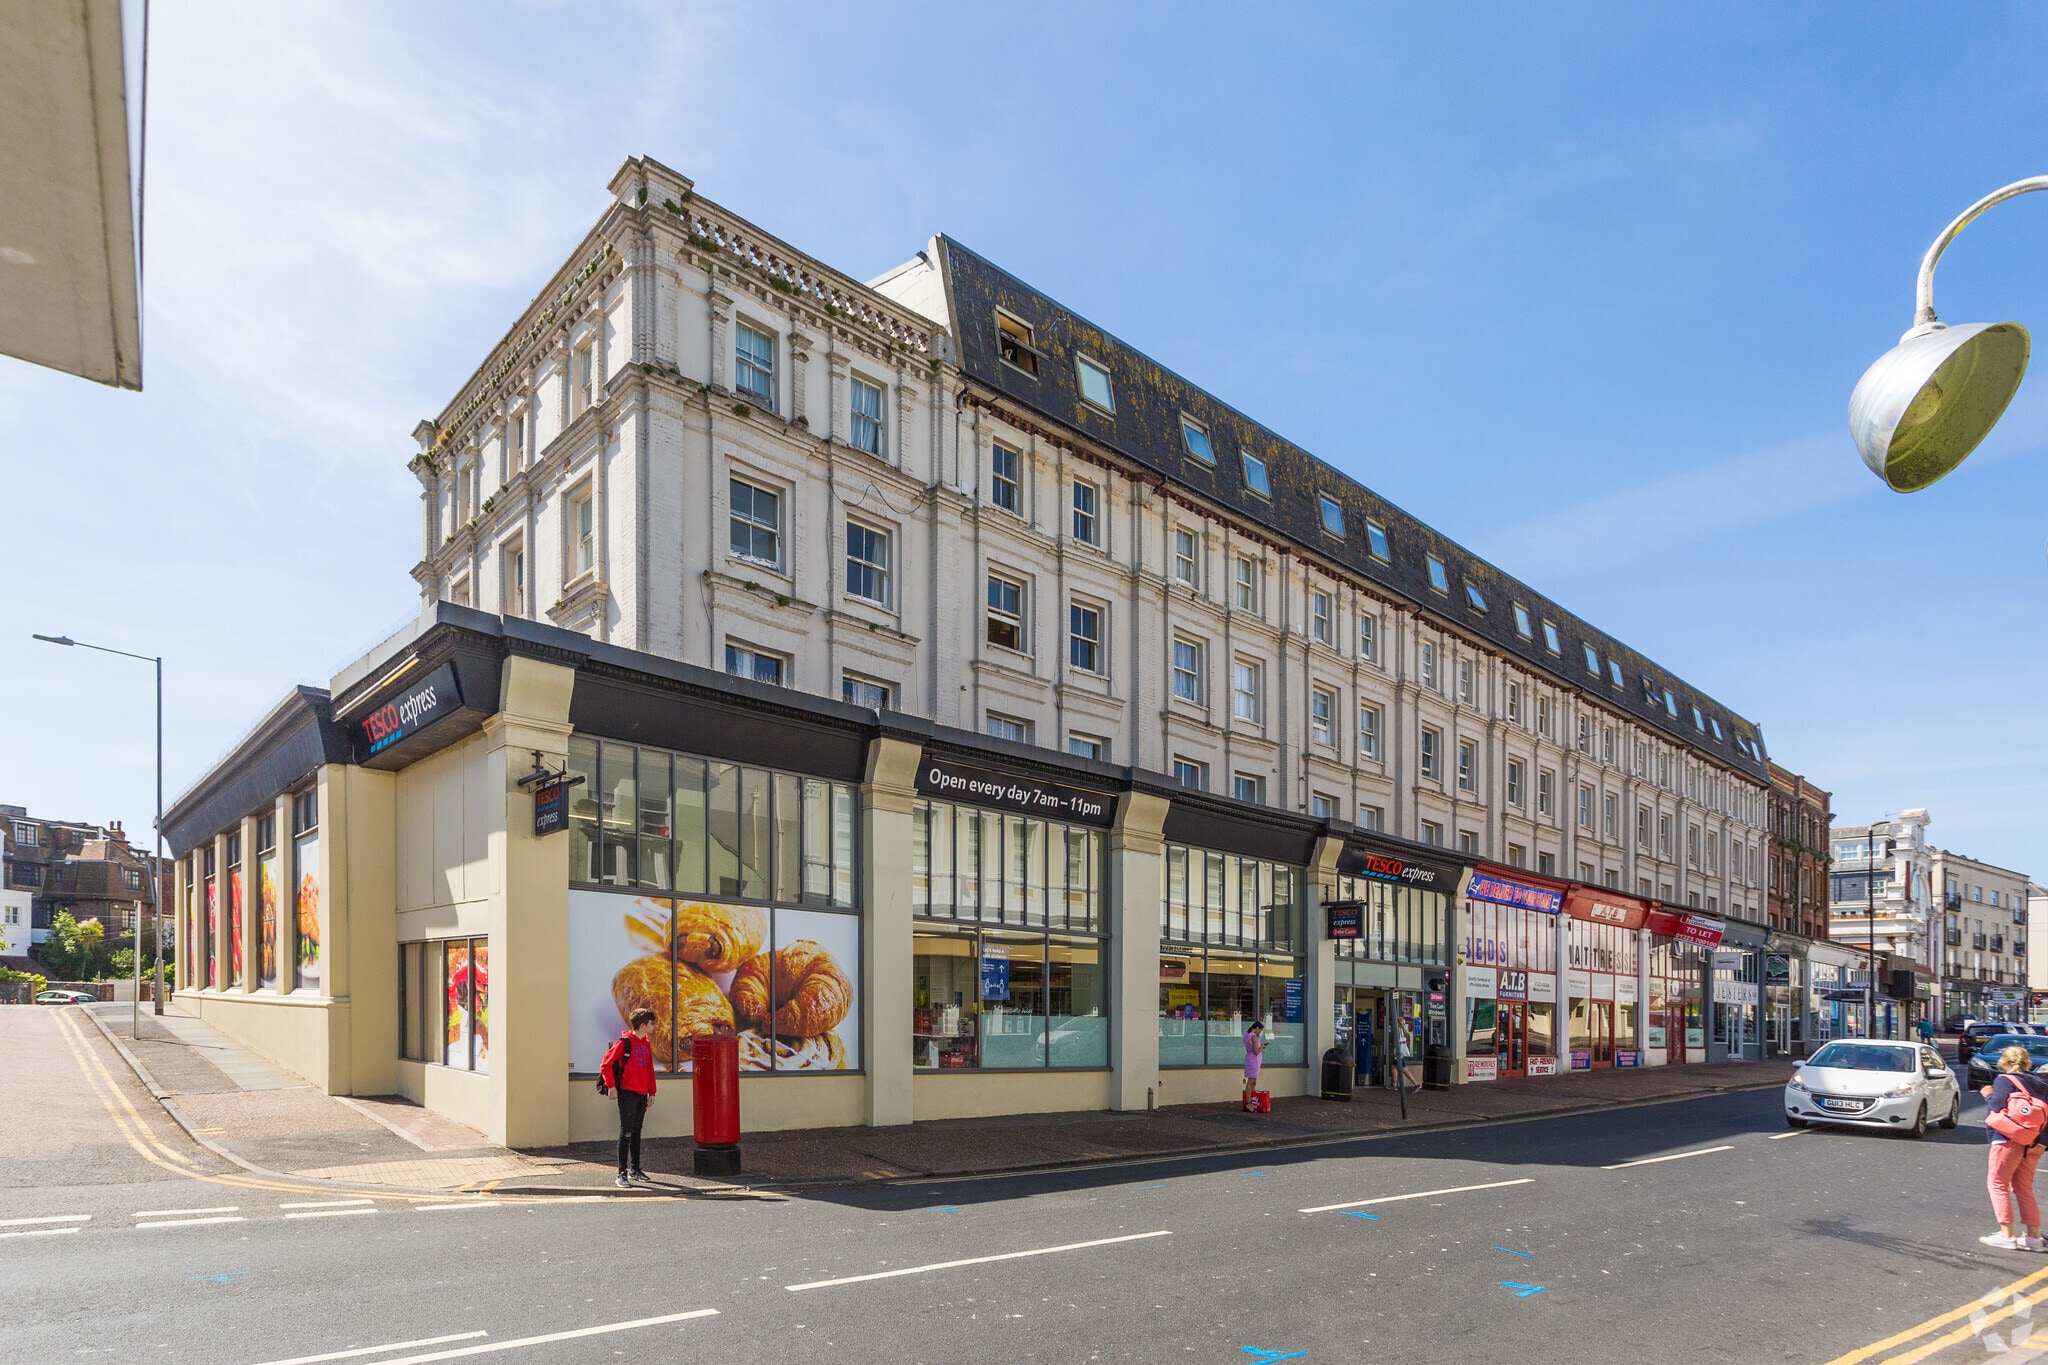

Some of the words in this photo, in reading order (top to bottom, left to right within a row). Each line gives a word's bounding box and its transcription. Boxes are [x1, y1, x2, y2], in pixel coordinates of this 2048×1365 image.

[362, 704, 399, 743] TESCO
[400, 686, 437, 727] express
[536, 787, 560, 806] TESCO
[929, 768, 966, 789] Open
[969, 781, 1006, 800] every
[1008, 785, 1031, 805] day
[1033, 789, 1058, 808] 7am
[1070, 797, 1101, 816] 11pm
[536, 812, 558, 830] express
[1366, 854, 1403, 876] TESCO
[1402, 867, 1435, 883] express
[1489, 882, 1514, 902] DELIVER
[1600, 907, 1619, 918] A.T.B
[1686, 926, 1697, 935] TO
[1698, 929, 1713, 938] LET
[1500, 971, 1526, 991] A.T.B
[1500, 991, 1526, 999] FURNITURE
